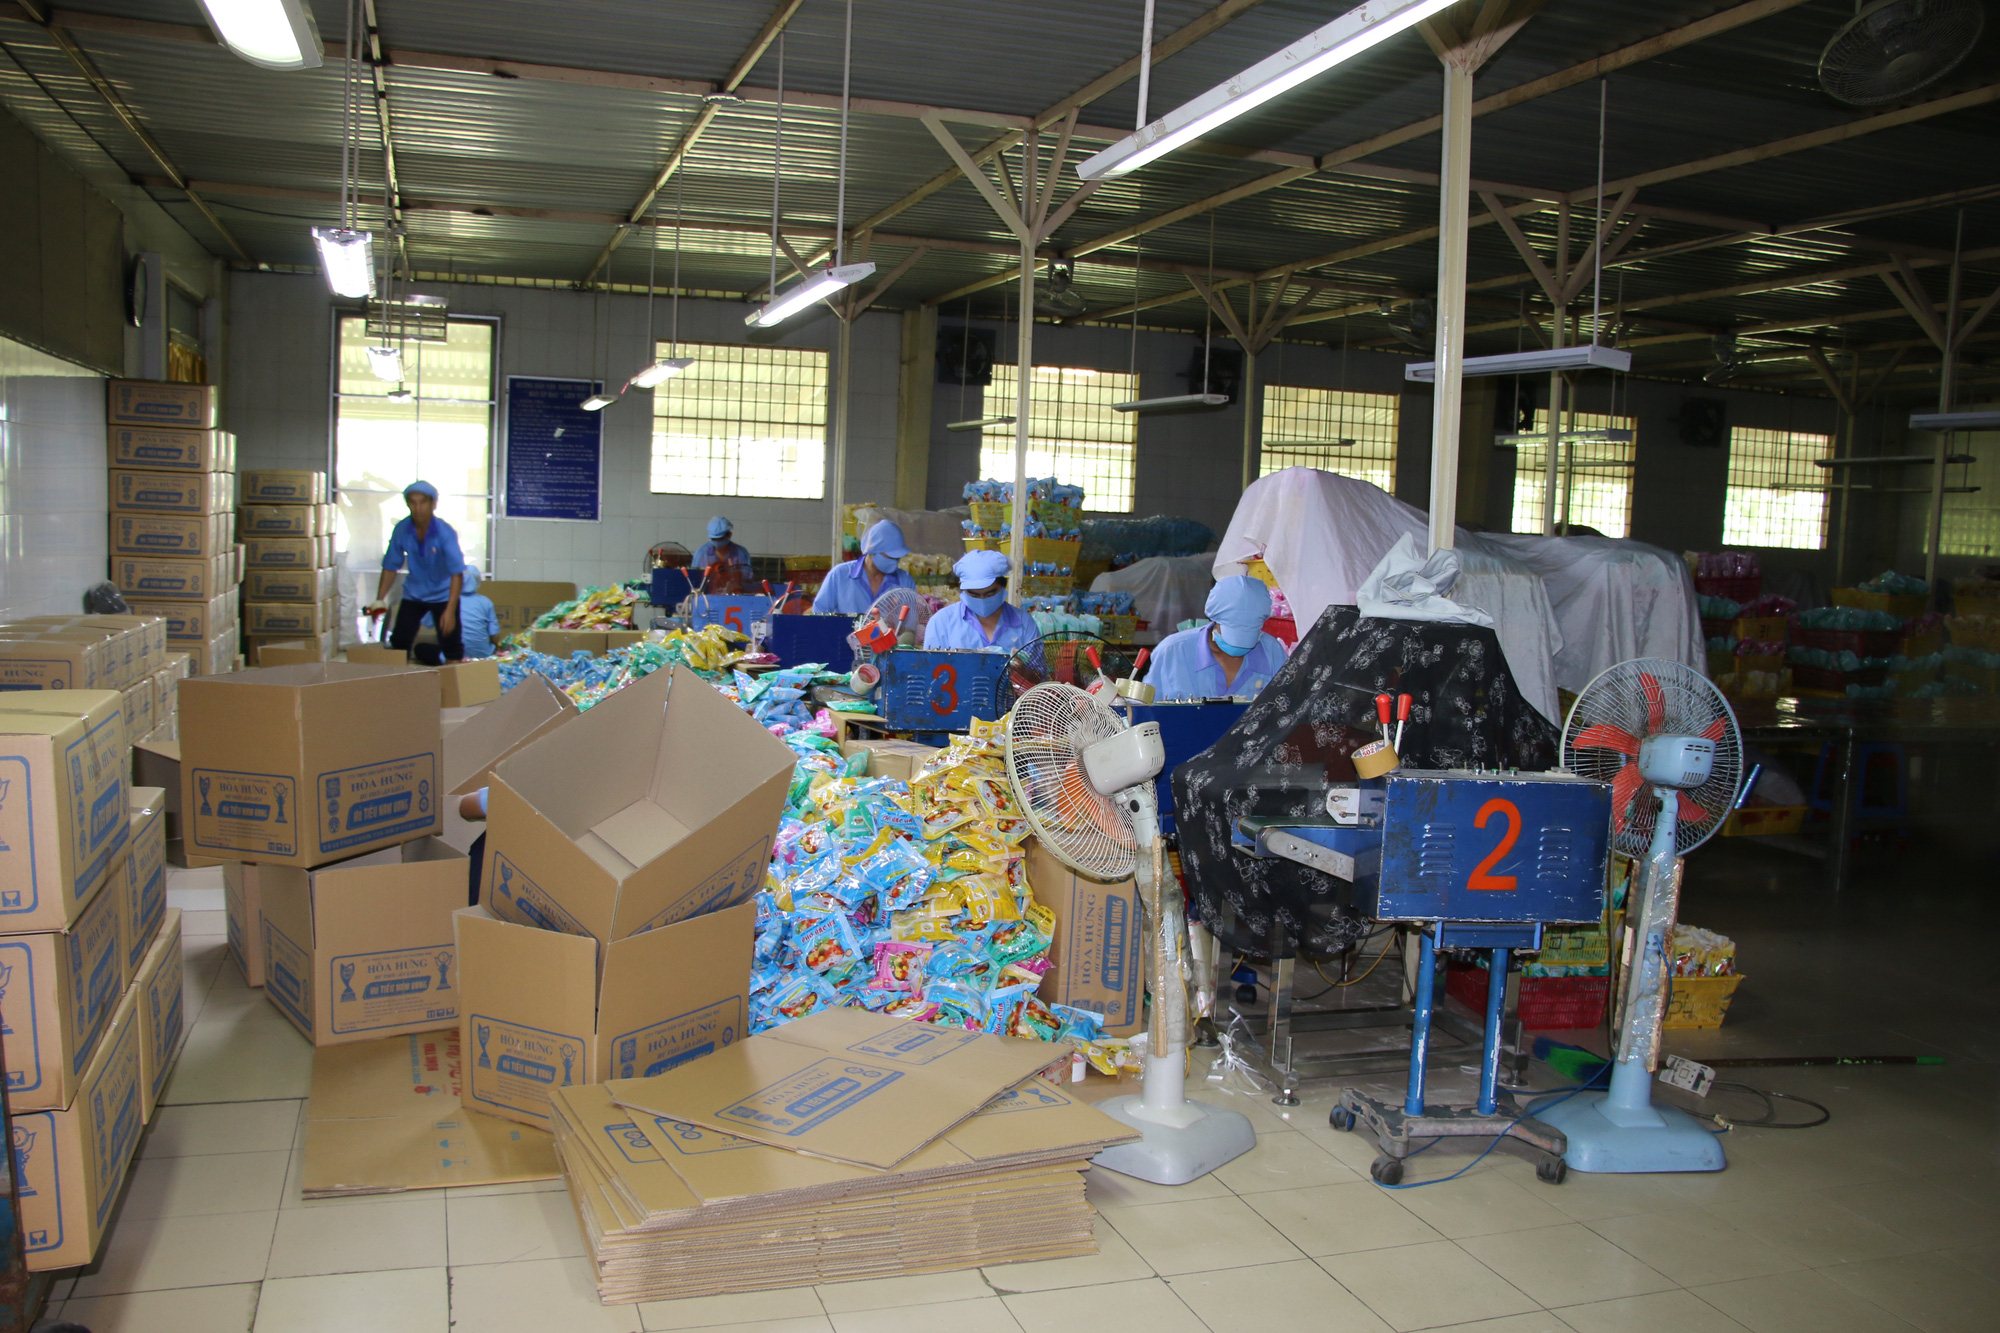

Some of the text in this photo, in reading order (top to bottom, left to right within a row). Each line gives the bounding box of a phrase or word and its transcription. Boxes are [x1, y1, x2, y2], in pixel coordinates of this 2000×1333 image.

[724, 606, 743, 633] 5
[931, 663, 959, 716] 3
[220, 781, 268, 796] HÒA HƯNG
[351, 778, 377, 793] HÒA
[381, 771, 414, 787] HƯNG
[1466, 797, 1522, 891] 2
[1111, 899, 1124, 924] VANG
[1080, 893, 1097, 985] HÒA HƯNG
[1109, 925, 1122, 946] NAM
[367, 959, 428, 974] HÒA HƯNG
[1104, 947, 1120, 968] TIẾU
[648, 1019, 717, 1053] HÒA HƯNG
[524, 1039, 553, 1056] HƯNG
[762, 1089, 794, 1106] HÒA
